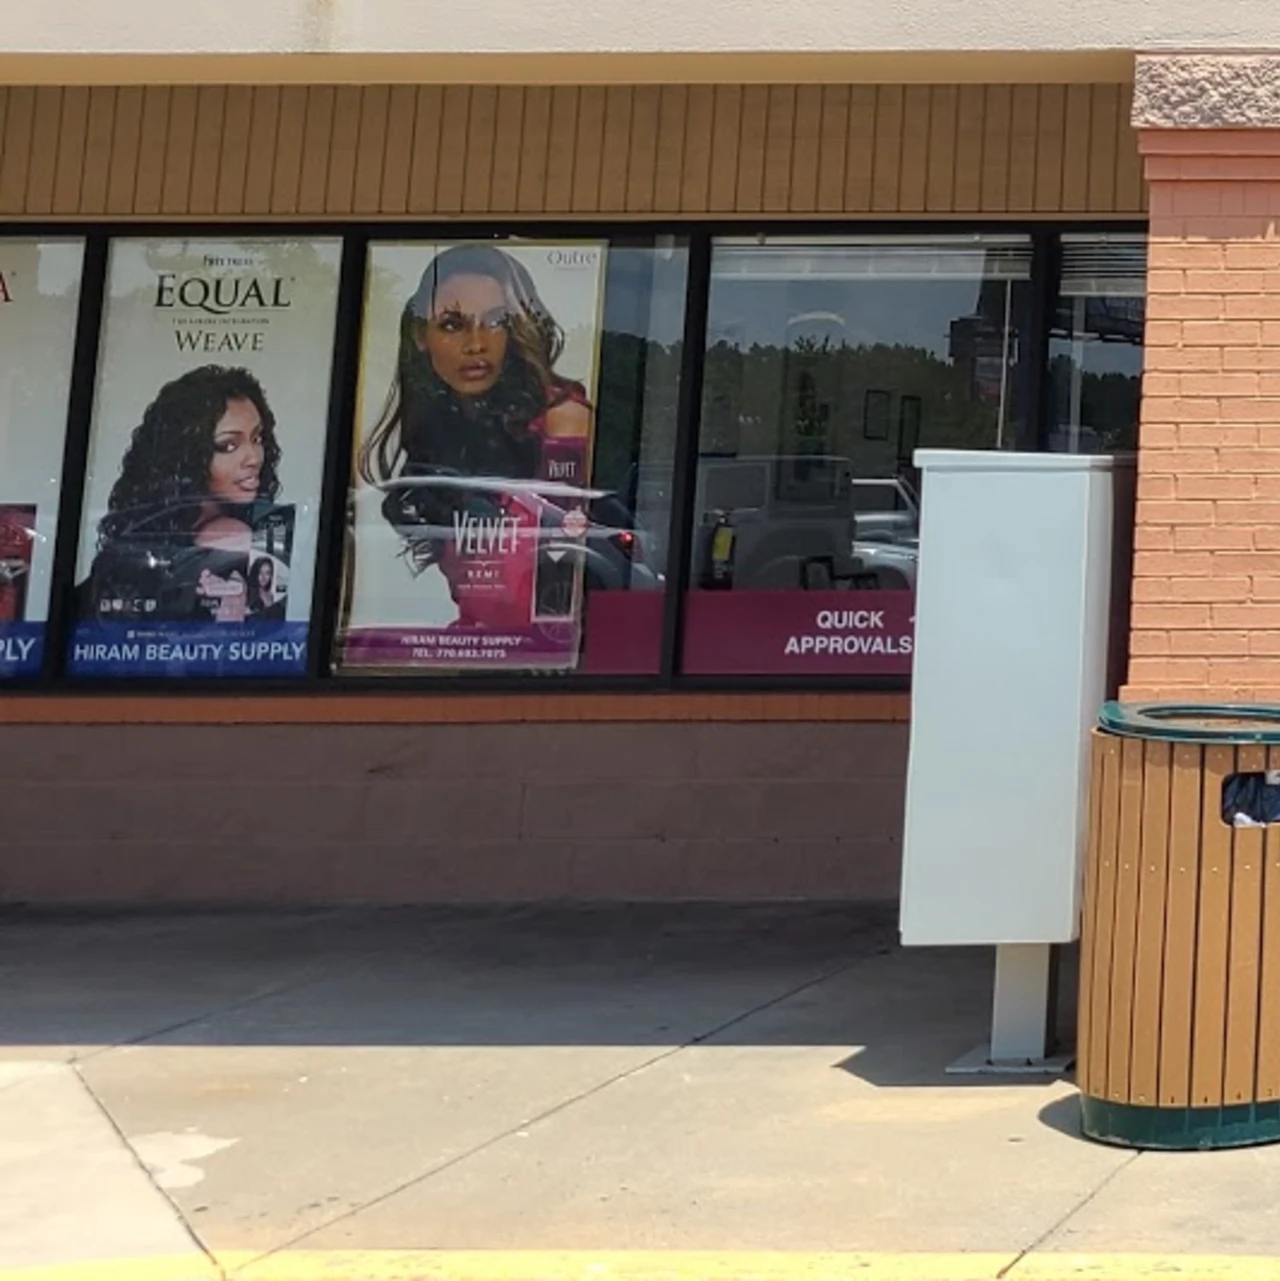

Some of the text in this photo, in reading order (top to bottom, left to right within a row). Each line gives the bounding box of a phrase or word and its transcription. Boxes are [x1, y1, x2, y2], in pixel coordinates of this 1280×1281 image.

[154, 273, 292, 315] EQUAL
[175, 330, 265, 352] WEAVE
[453, 510, 521, 556] VELVET
[816, 610, 884, 630] QUICK
[438, 634, 479, 646] BEAUTY
[481, 635, 522, 646] SUPPLY
[784, 635, 913, 655] APPROVALS
[73, 641, 307, 662] HIRAM BEAUTY SUPPLY
